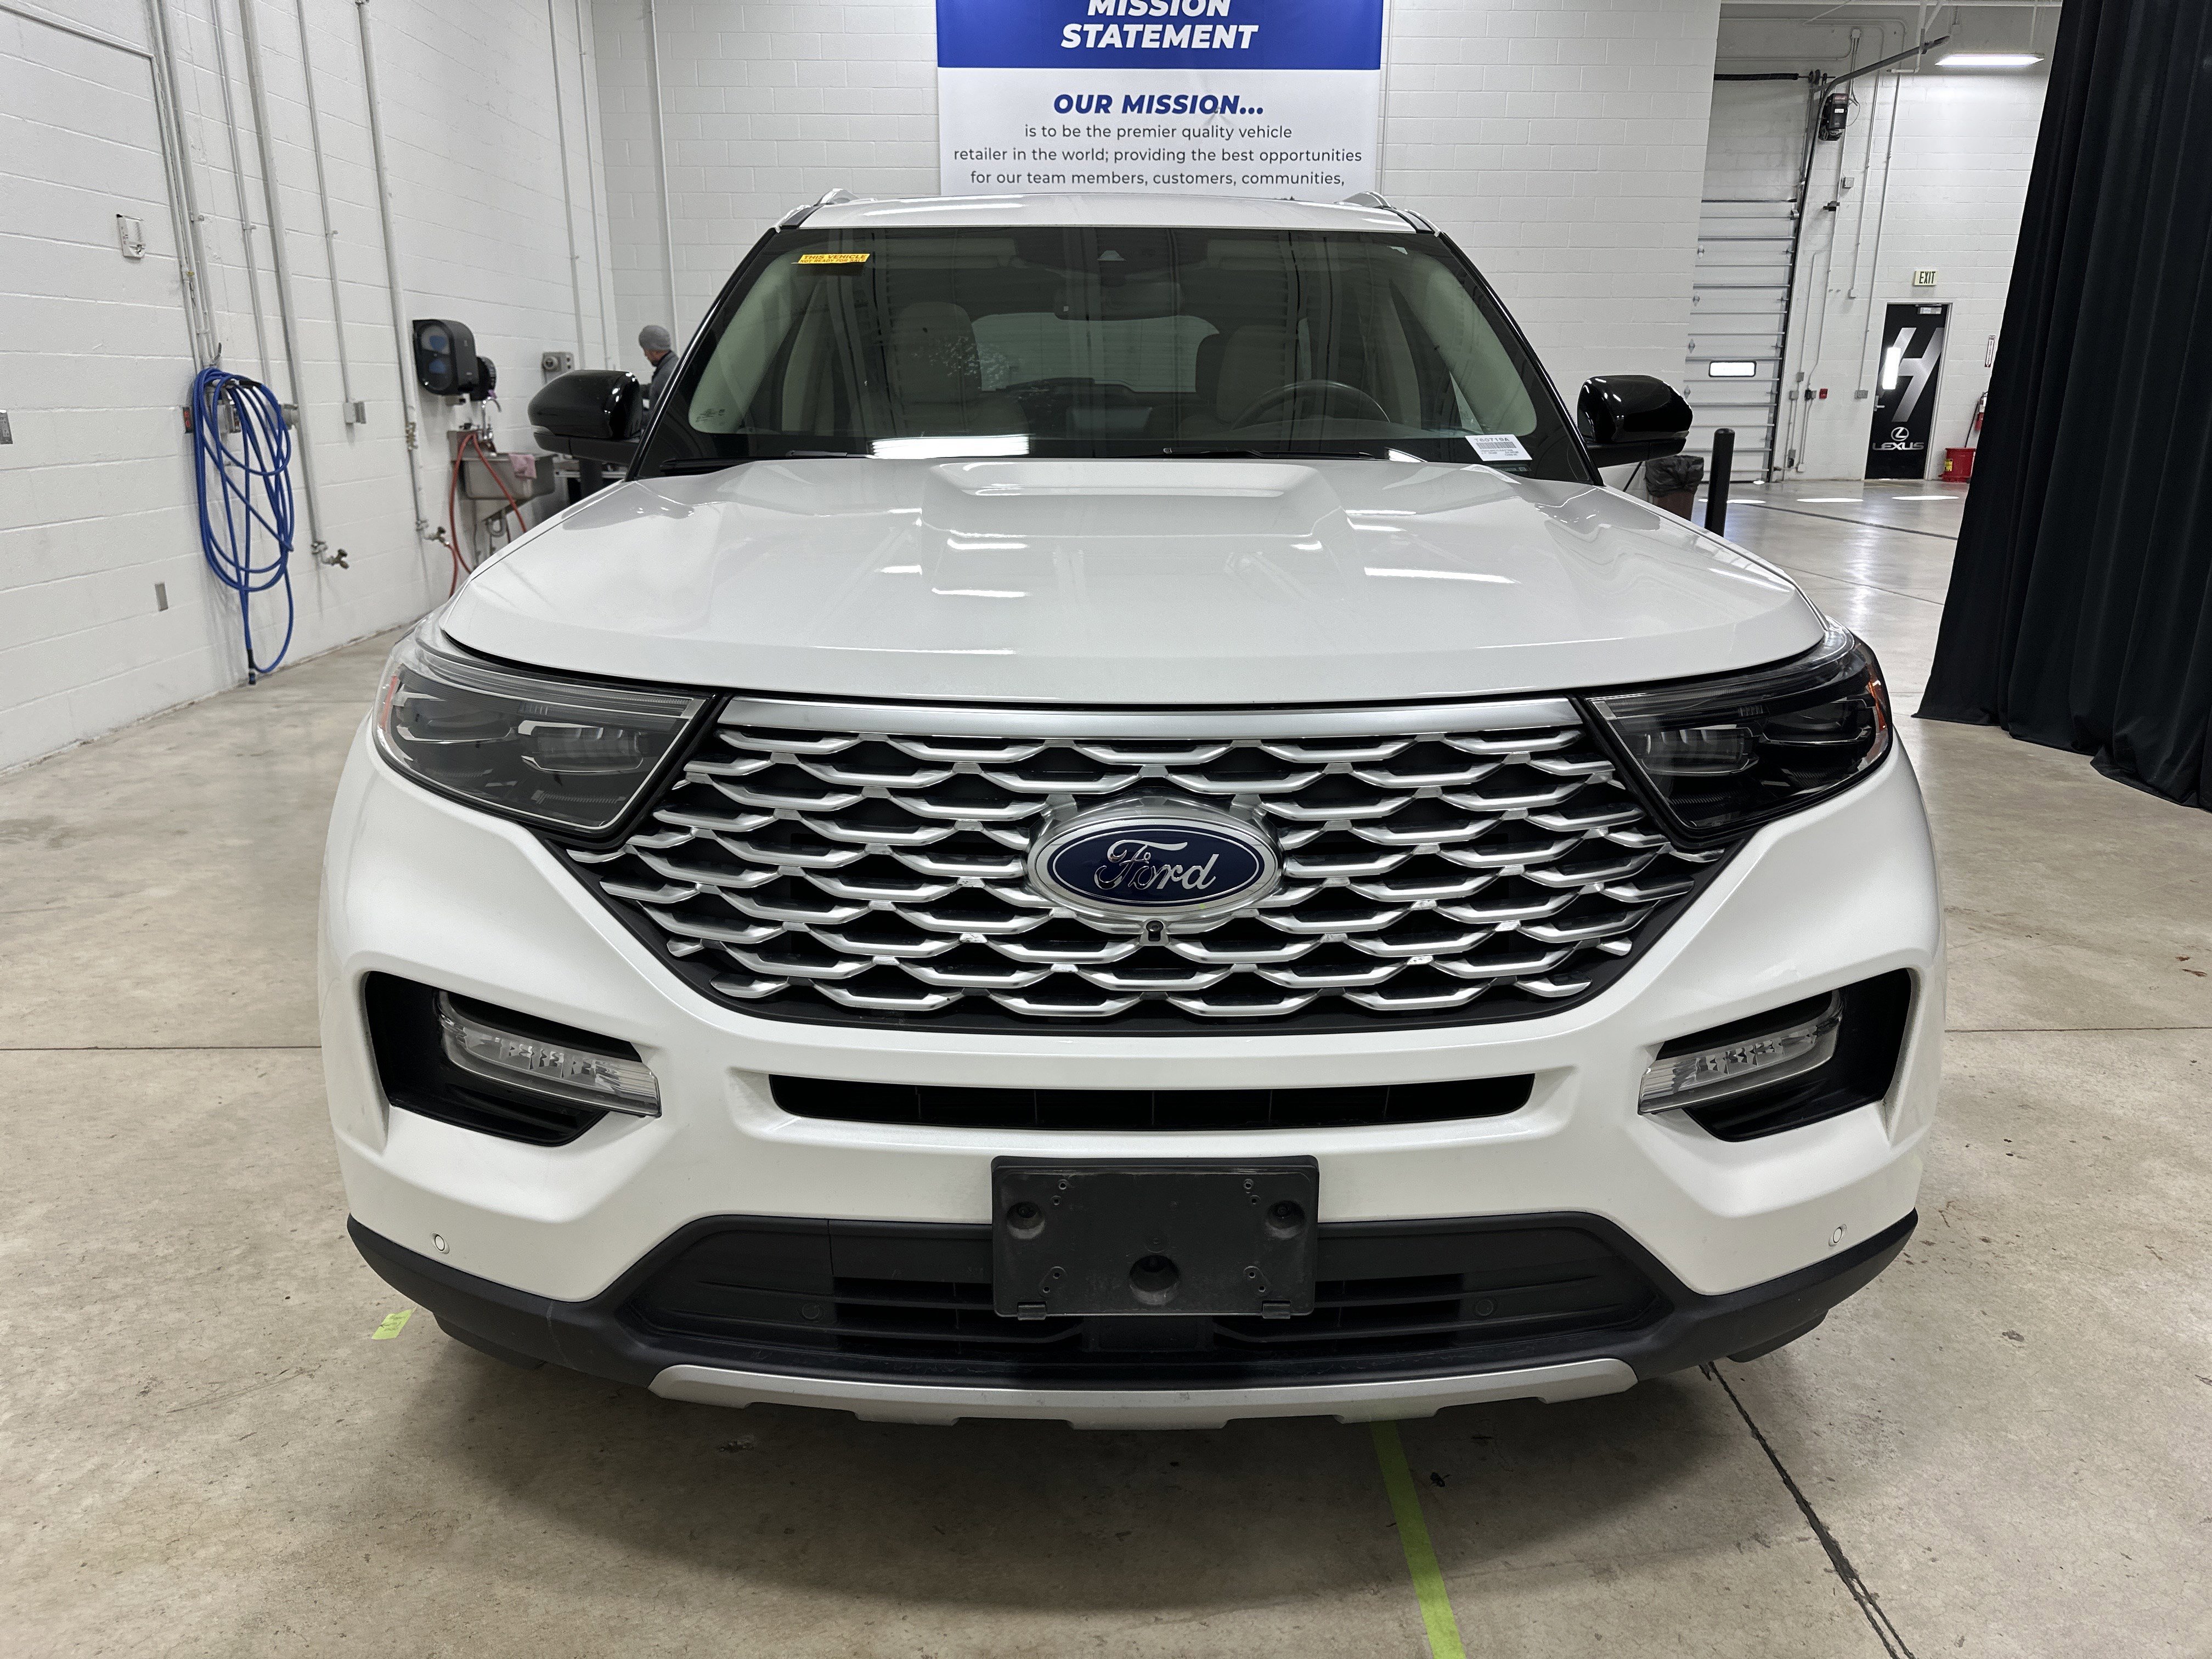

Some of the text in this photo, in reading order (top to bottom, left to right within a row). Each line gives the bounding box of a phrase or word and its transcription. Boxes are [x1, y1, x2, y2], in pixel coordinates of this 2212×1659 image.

[1088, 0, 1230, 17] MISSION
[1060, 24, 1259, 49] STATEMENT
[1054, 94, 1263, 115] OUR MISSION...
[1025, 125, 1292, 141] is to be the premier quality vehicle
[955, 148, 1362, 163] retailer in the world; providing the best opportunities
[971, 171, 1344, 186] for our team members, customers, communities,
[1919, 271, 1936, 284] EXIT
[1872, 442, 1925, 451] LEXUS
[1093, 839, 1219, 890] Ford
